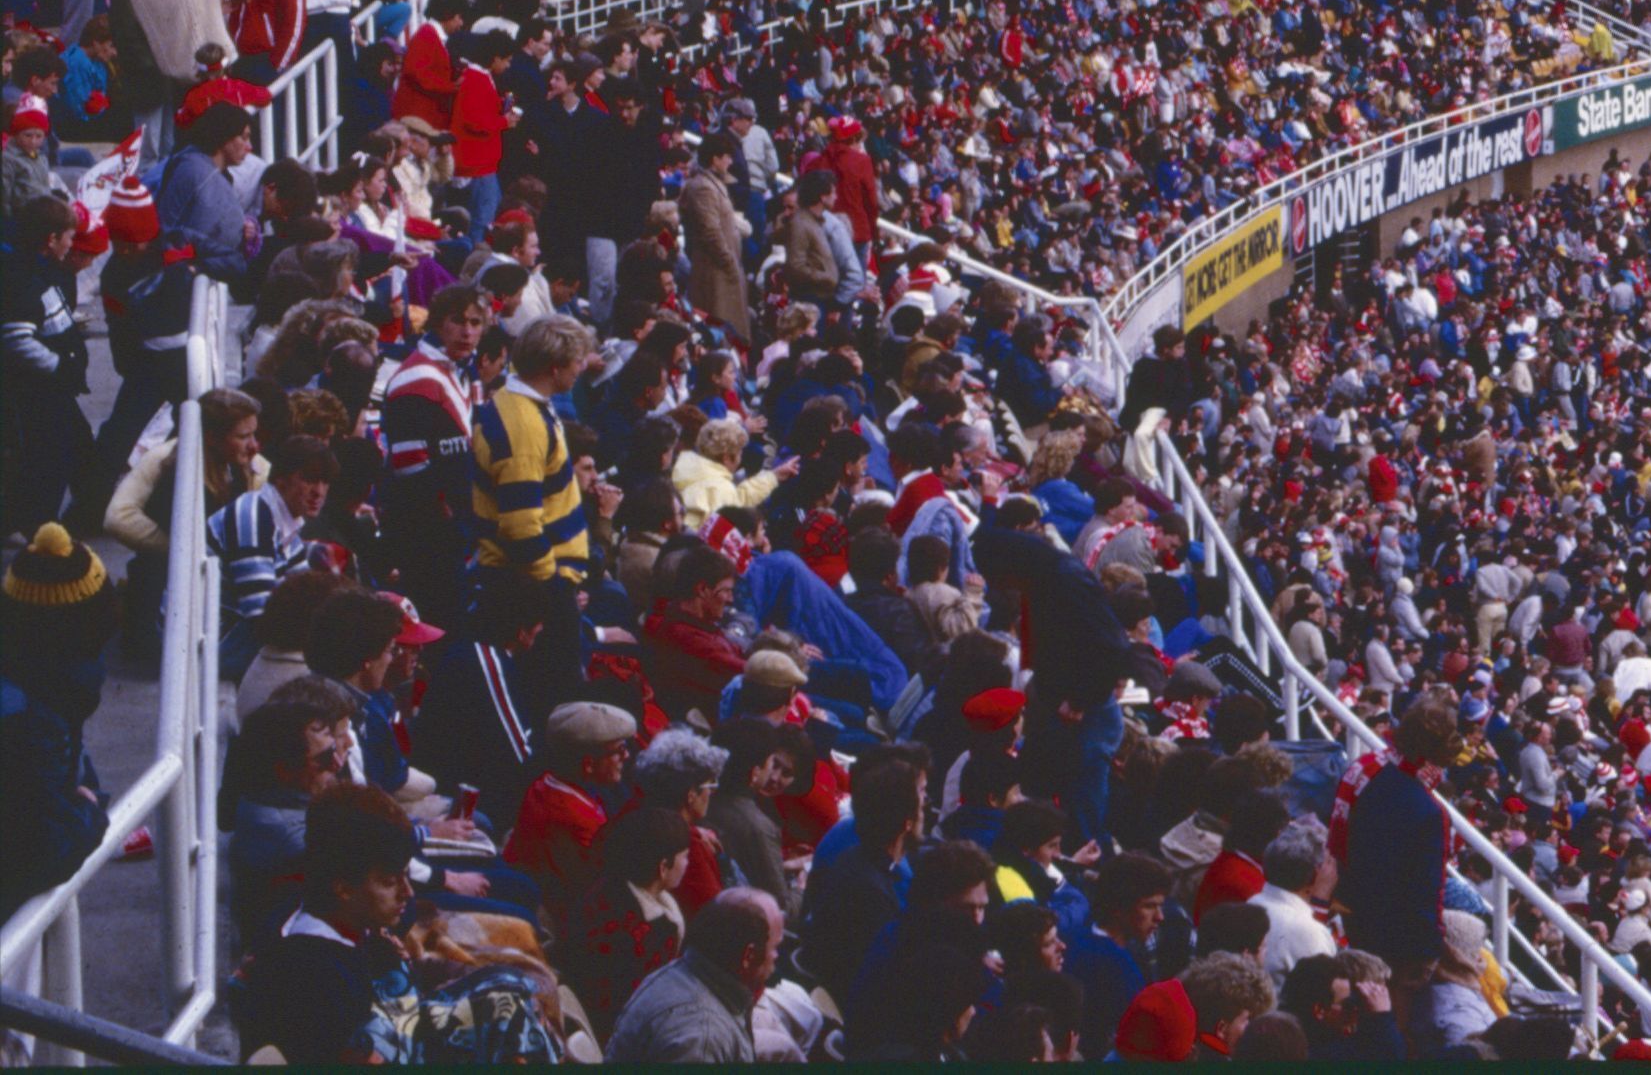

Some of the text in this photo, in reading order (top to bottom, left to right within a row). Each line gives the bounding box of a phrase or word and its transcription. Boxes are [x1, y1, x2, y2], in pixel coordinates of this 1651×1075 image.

[1577, 90, 1621, 137] State
[1449, 128, 1466, 184] of
[1467, 126, 1493, 179] the
[1495, 116, 1524, 167] rest
